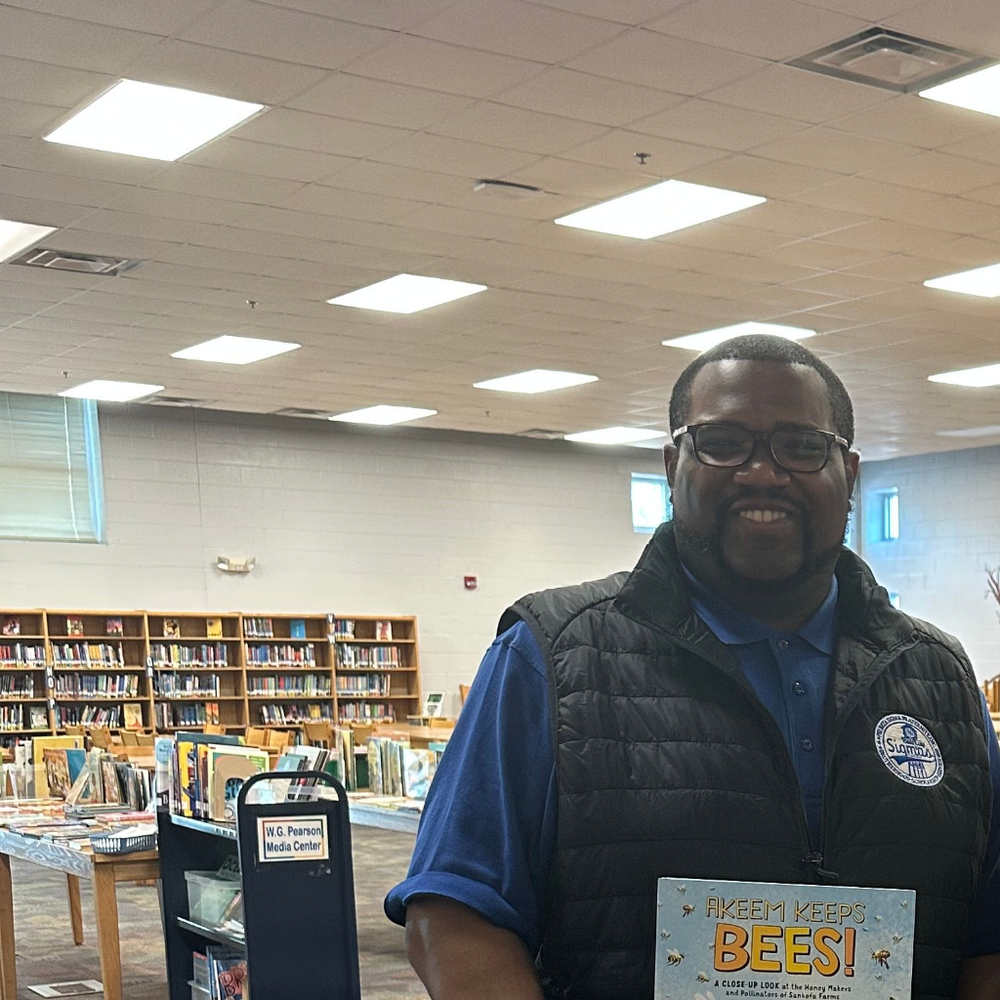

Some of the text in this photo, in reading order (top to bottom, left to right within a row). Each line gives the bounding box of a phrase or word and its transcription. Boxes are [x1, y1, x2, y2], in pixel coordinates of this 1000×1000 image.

[266, 826, 322, 838] W.G. Pearson
[266, 840, 321, 852] Media Center
[705, 896, 866, 924] AKEEM KEEPS
[713, 922, 856, 978] BEES!
[722, 980, 758, 988] CLOSE-UP
[760, 982, 780, 990] LOOK
[804, 984, 826, 992] Honey
[828, 984, 852, 992] Makers
[740, 990, 778, 998] Pollinators
[818, 992, 840, 1000] Farms
